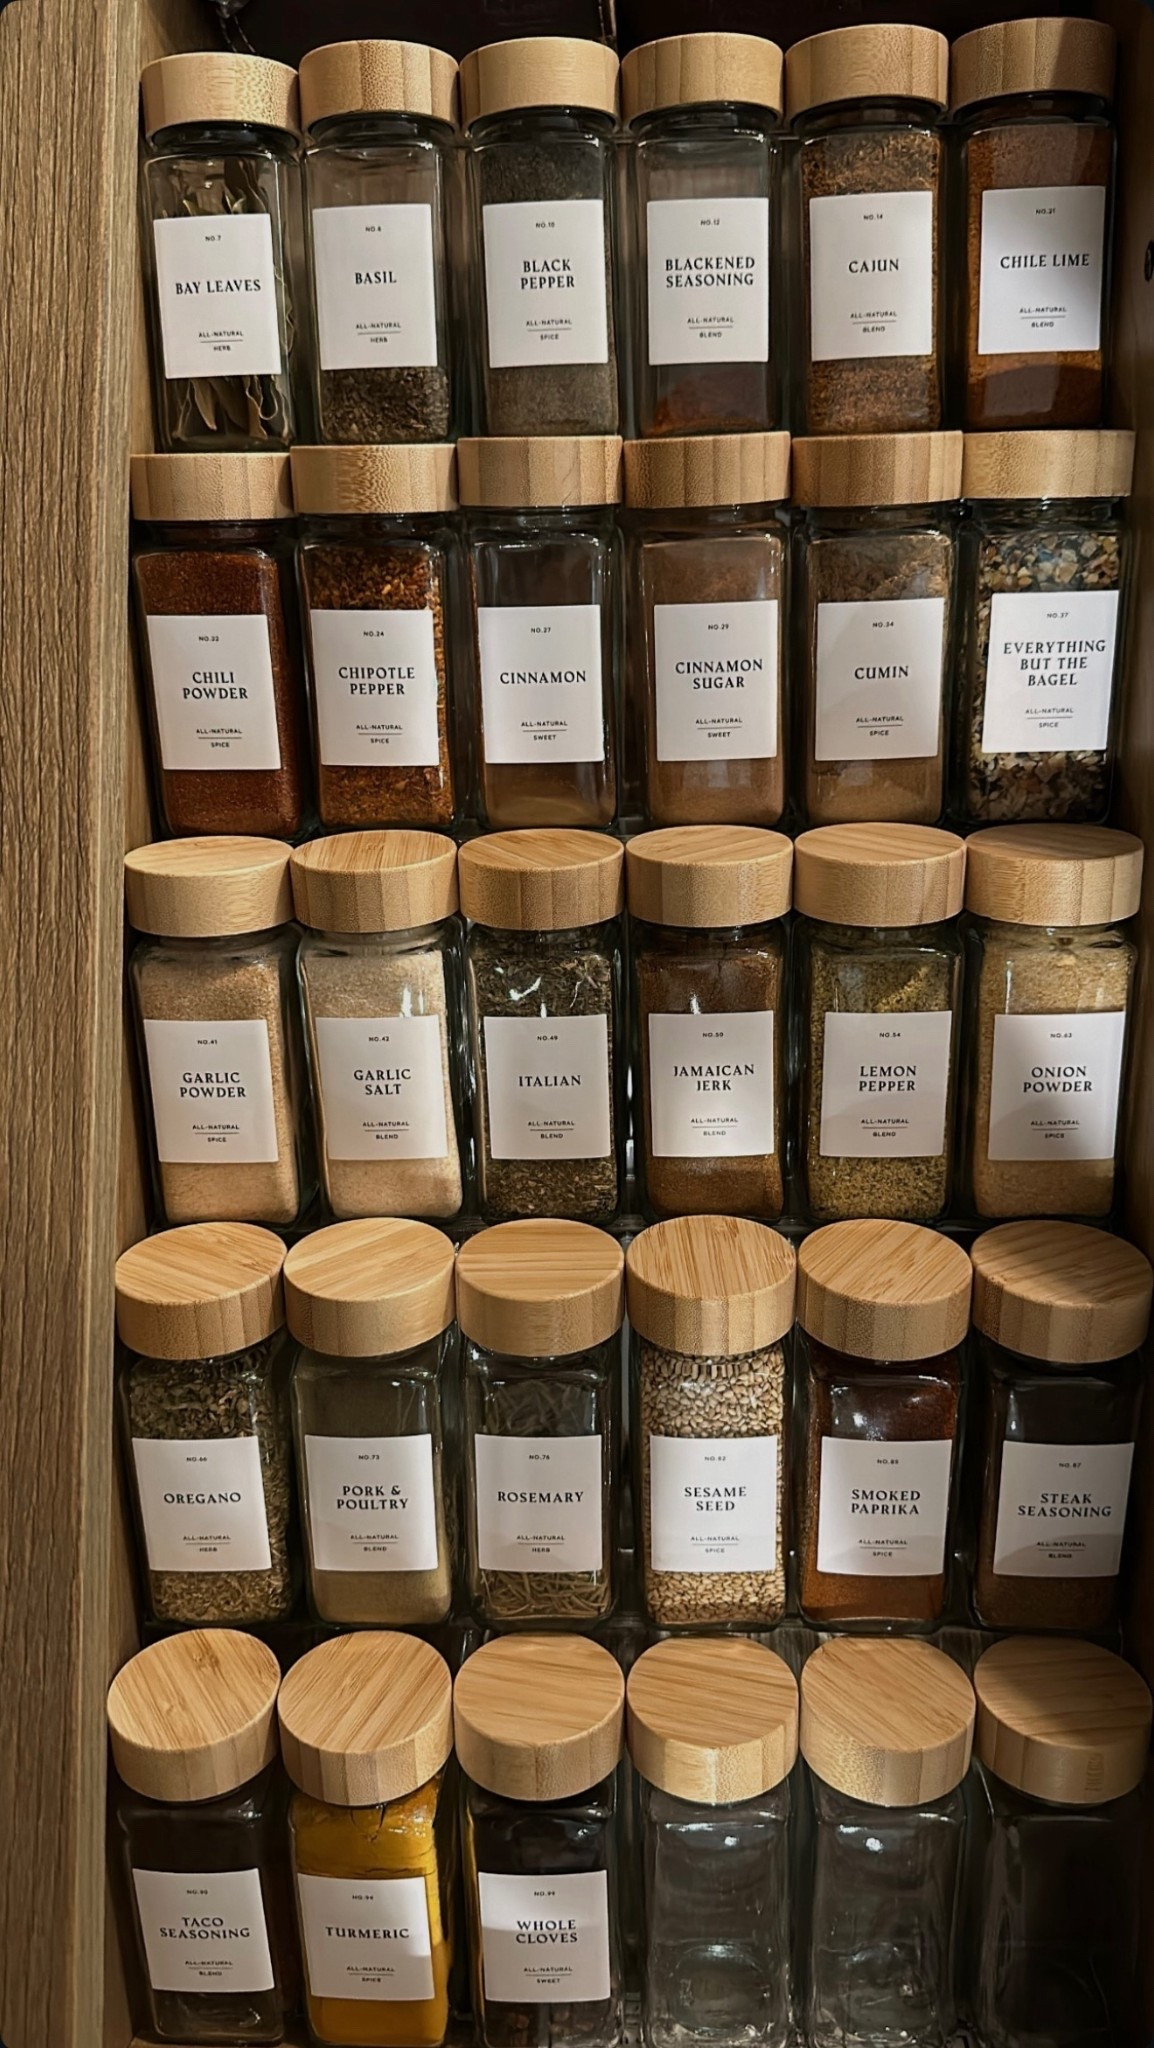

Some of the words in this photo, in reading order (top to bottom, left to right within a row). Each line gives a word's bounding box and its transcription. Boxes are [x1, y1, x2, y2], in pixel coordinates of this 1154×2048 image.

[523, 258, 571, 273] BLACK
[665, 256, 756, 272] BLACKENED
[848, 258, 899, 274] CAJUN
[1000, 254, 1047, 269] CHILE
[1052, 253, 1090, 268] LIME
[355, 270, 397, 285] BASIL
[520, 275, 575, 290] PEPPER
[666, 272, 754, 289] SEASONING
[175, 281, 201, 295] BAY
[206, 278, 261, 294] LEAVES
[850, 310, 897, 319] ALL-NATURAL
[1019, 306, 1067, 314] ALL-NATURAL
[355, 321, 401, 330] ALL-NATURAL
[525, 318, 572, 327] ALL-NATURAL
[687, 316, 734, 324] ALL-NATURAL
[198, 330, 244, 338] ALL-NATURAL
[699, 331, 723, 339] BLEND
[862, 325, 886, 333] BLEND
[370, 336, 388, 344] HERB
[539, 333, 559, 341] SPICE
[213, 344, 231, 352] HERB
[1003, 639, 1106, 655] EVERYTHING
[675, 658, 763, 675] CINNAMON
[1020, 657, 1052, 671] BUT
[1057, 656, 1088, 670] THE
[192, 671, 235, 684] CHILI
[338, 666, 415, 680] CHIPOTLE
[499, 670, 587, 685] CINNAMON
[854, 665, 909, 680] CUMIN
[693, 675, 745, 690] SUGAR
[1027, 672, 1078, 687] BAGEL
[182, 687, 249, 700] POWDER
[349, 682, 405, 696] PEPPER
[1025, 707, 1074, 715] ALL-NATURAL
[520, 720, 568, 728] ALL-NATURAL
[695, 717, 743, 725] ALL-NATURAL
[855, 715, 904, 723] ALL-NATURAL
[1038, 721, 1059, 729] SPICE
[195, 727, 243, 735] ALL-NATURAL
[707, 731, 731, 739] SWEET
[869, 729, 890, 737] SPICE
[370, 737, 390, 745] SPICE
[353, 1068, 412, 1081] GARLIC
[673, 1063, 755, 1077] JAMAICAN
[859, 1065, 917, 1078] LEMON
[1031, 1065, 1087, 1079] ONION
[182, 1071, 241, 1084] GARLIC
[518, 1074, 581, 1087] ITALIAN
[364, 1083, 402, 1096] SALT
[696, 1079, 732, 1092] JERK
[858, 1079, 916, 1092] PEPPER
[1023, 1080, 1093, 1094] POWDER
[179, 1086, 247, 1099] POWDER
[362, 1120, 410, 1128] ALL-NATURAL
[1030, 1119, 1080, 1127] ALL-NATURAL
[540, 1132, 564, 1140] BLEND
[163, 1491, 242, 1505] OREGANO
[342, 1485, 386, 1498] PORK
[390, 1485, 402, 1496] &
[497, 1491, 584, 1504] ROSEMARY
[684, 1486, 747, 1498] SESAME
[851, 1488, 921, 1502] SMOKED
[336, 1498, 409, 1511] POULTRY
[1040, 1492, 1092, 1505] STEAK
[696, 1500, 735, 1512] SEED
[851, 1502, 919, 1515] PAPRIKA
[1017, 1504, 1112, 1518] SEASONING
[181, 1916, 224, 1929] TACO
[516, 1919, 576, 1933] WHOLE
[159, 1927, 250, 1940] SEASONING
[325, 1926, 410, 1940] TURMERIC
[515, 1931, 578, 1944] CLOVES
[346, 1965, 395, 1973] ALL-NATURAL
